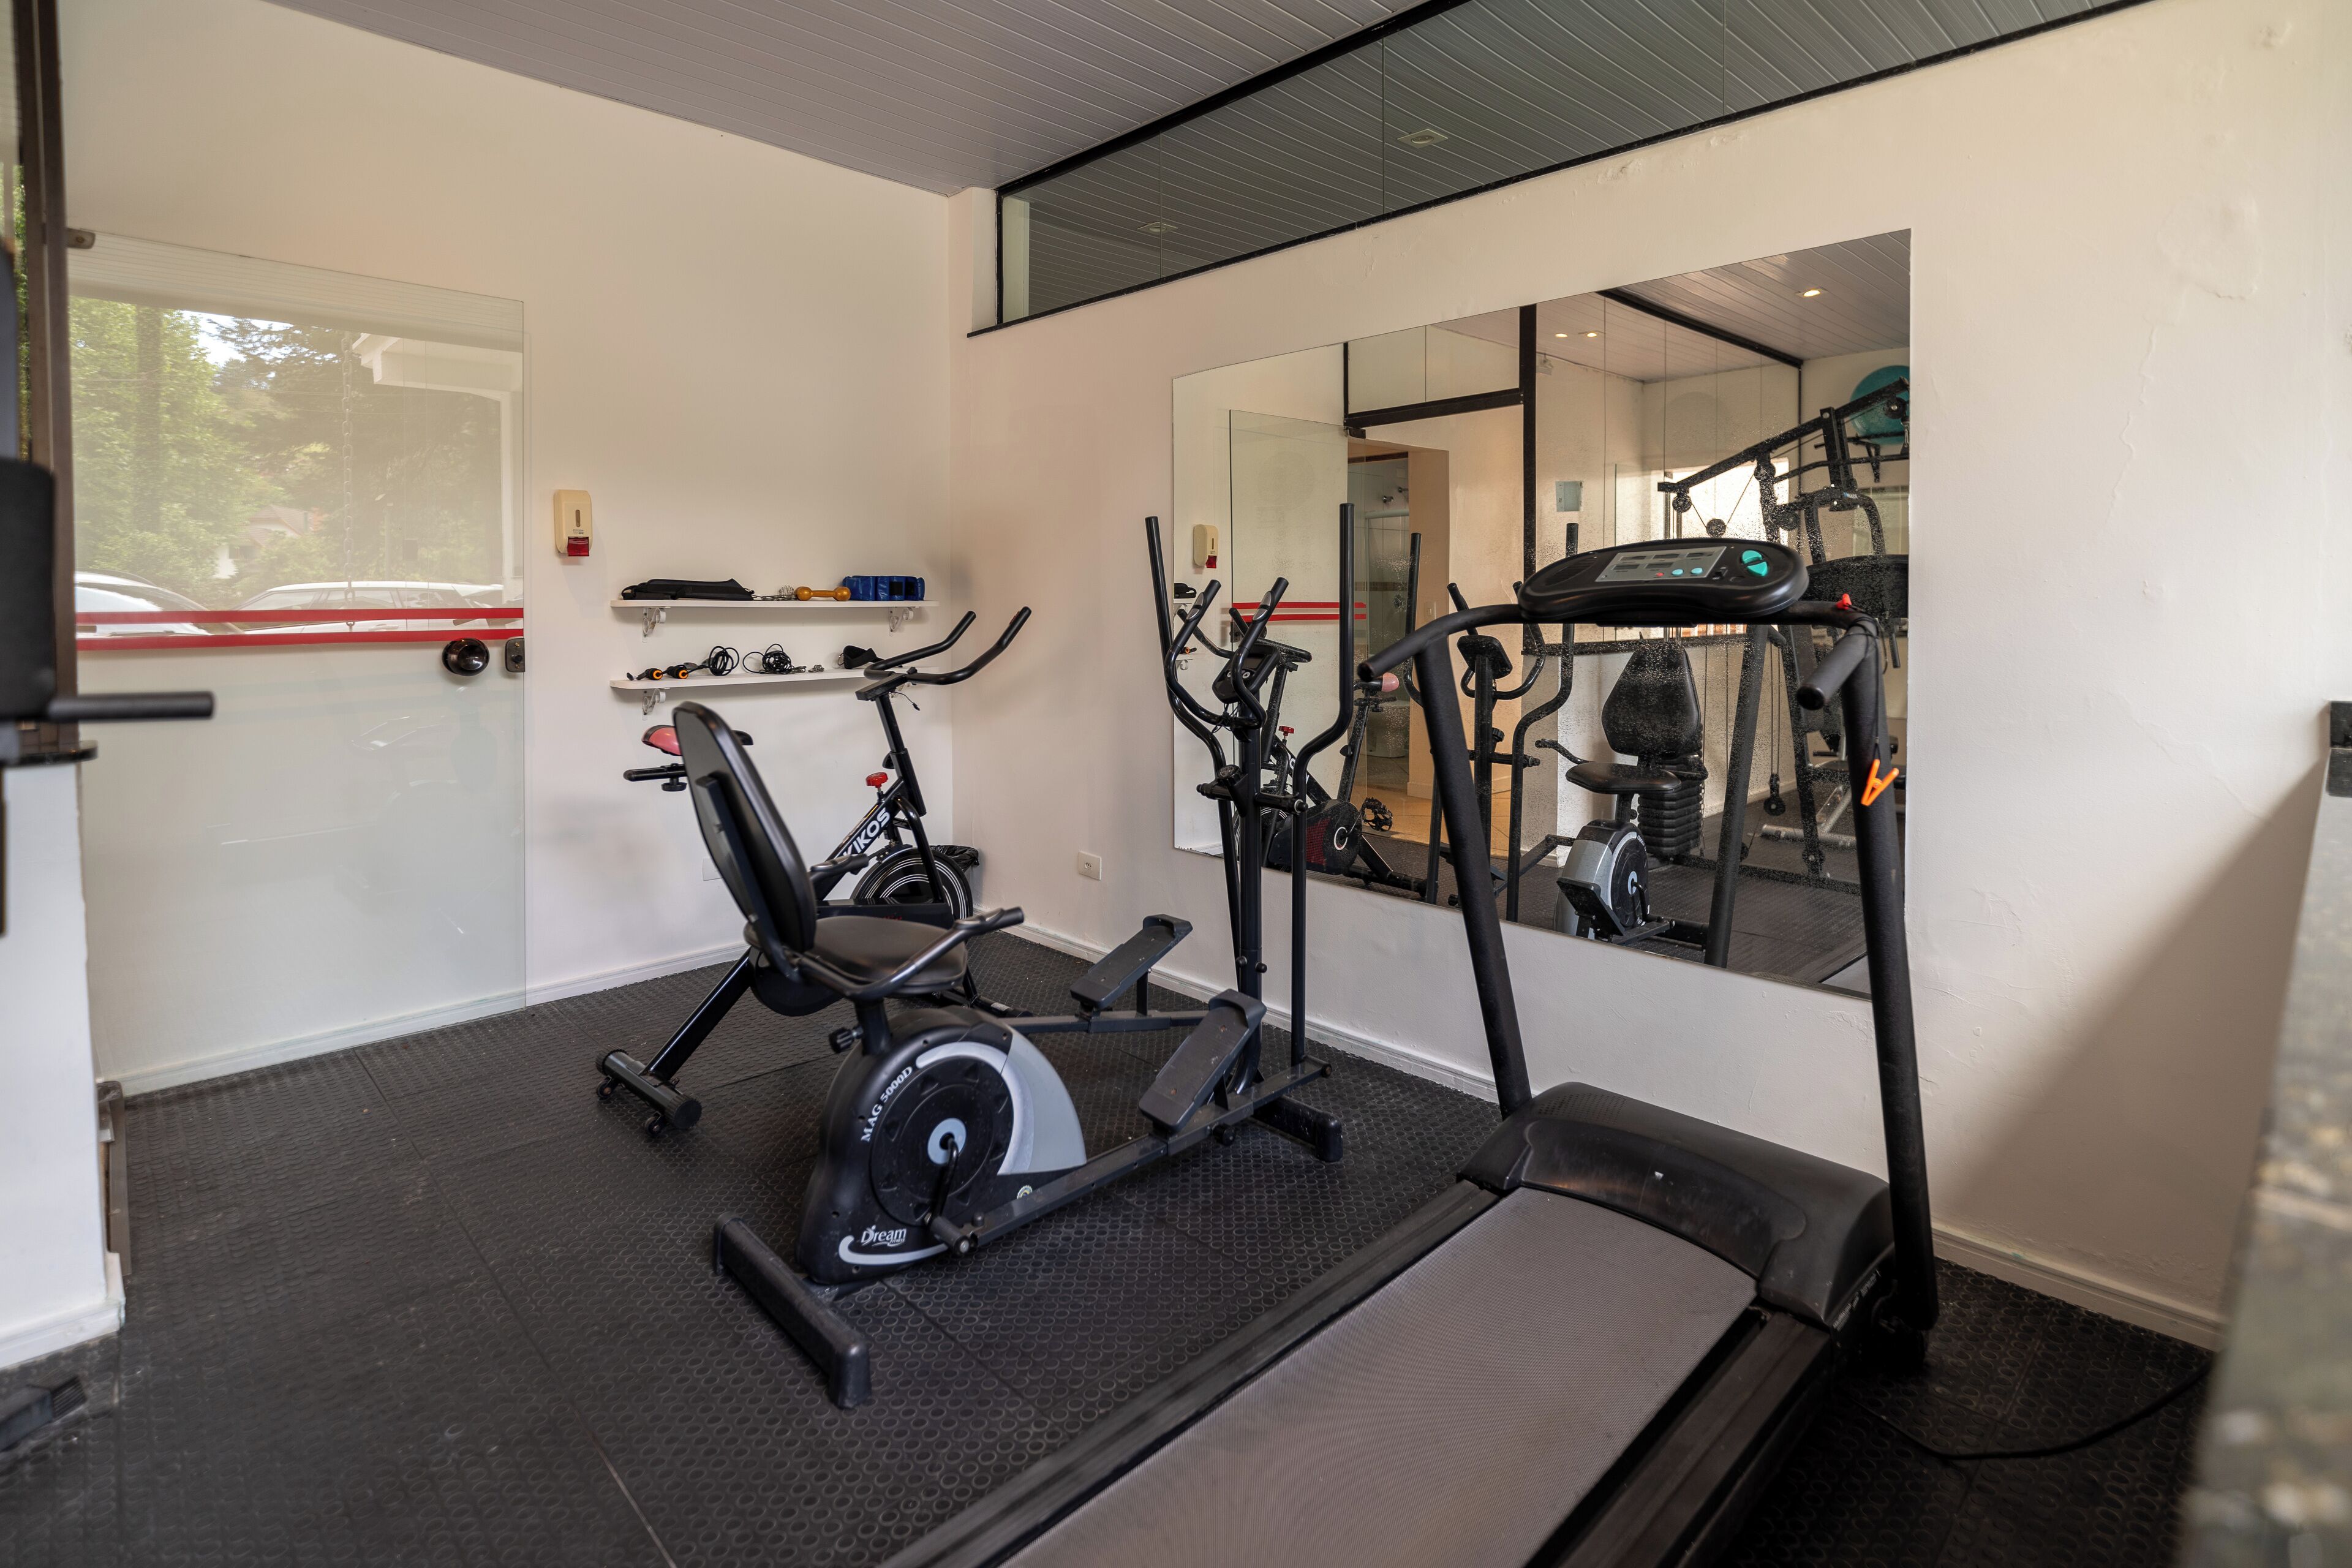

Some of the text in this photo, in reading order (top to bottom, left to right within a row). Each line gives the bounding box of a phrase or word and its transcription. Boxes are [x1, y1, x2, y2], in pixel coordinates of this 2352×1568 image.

[861, 1066, 913, 1142] MAG 5000D
[861, 1224, 907, 1246] Dream
